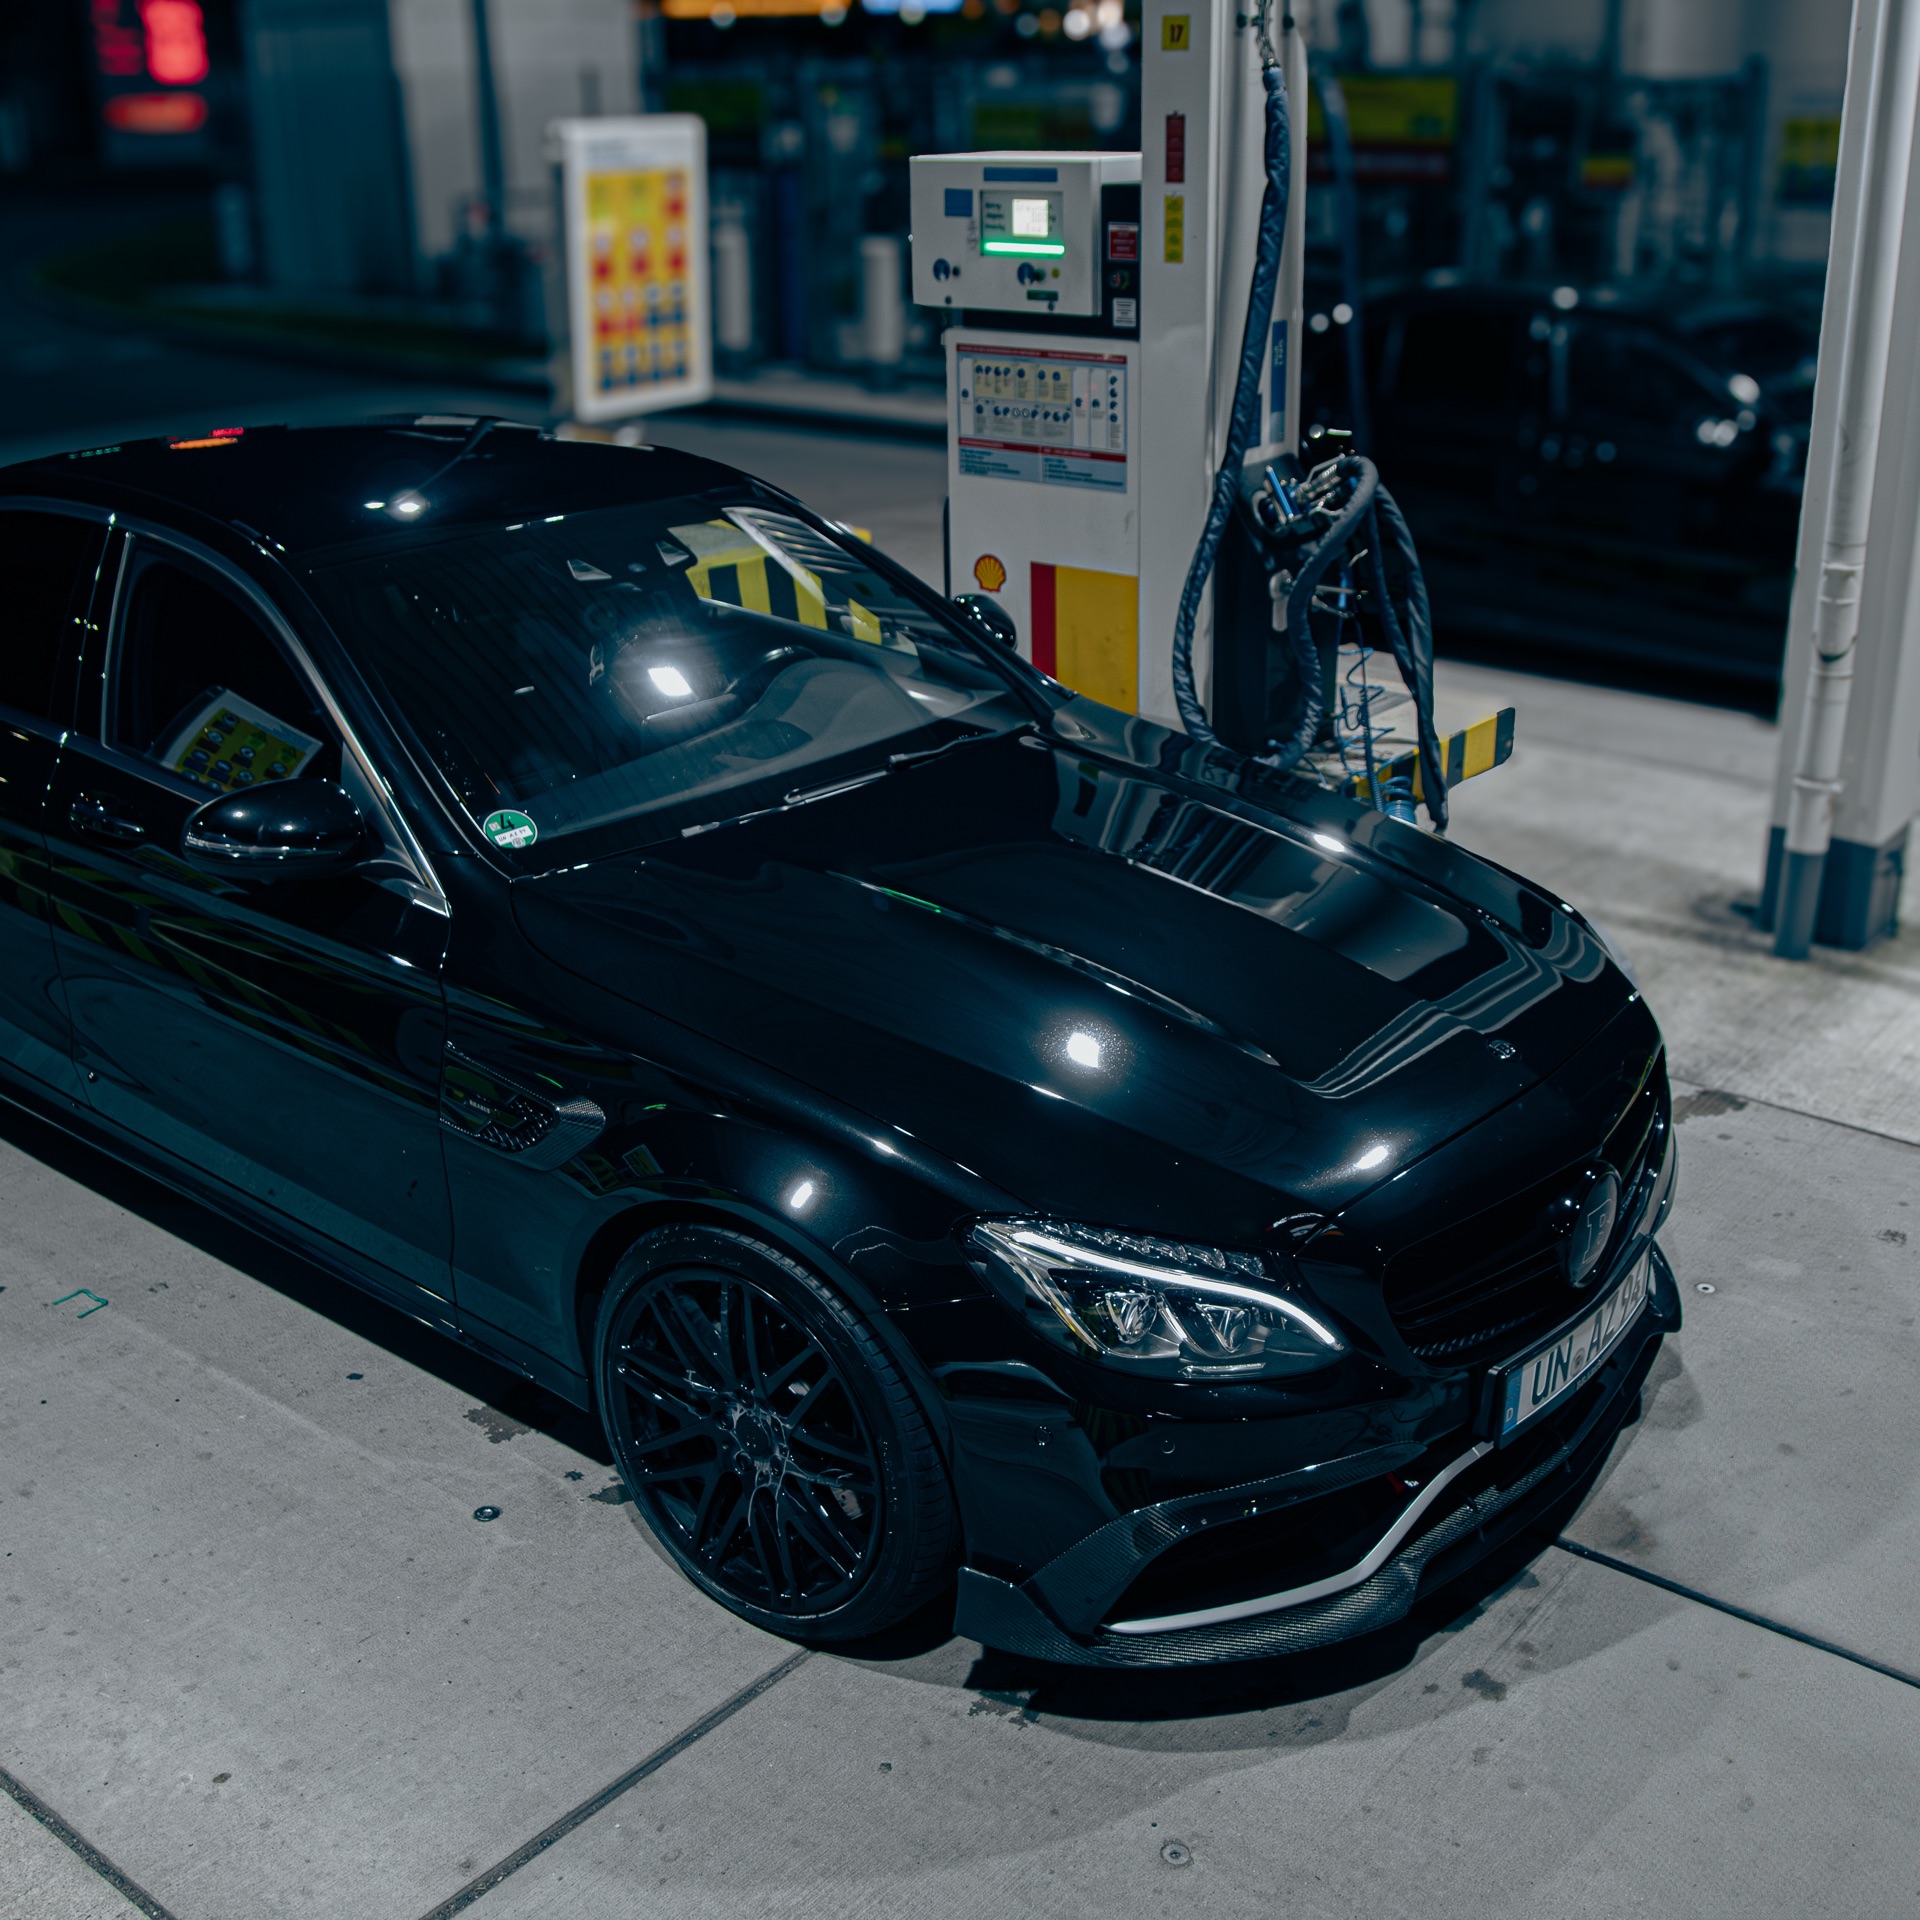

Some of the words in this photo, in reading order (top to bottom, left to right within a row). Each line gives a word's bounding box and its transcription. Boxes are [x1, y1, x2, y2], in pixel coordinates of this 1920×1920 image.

[1170, 24, 1184, 43] 17
[500, 813, 515, 829] 4
[1531, 1335, 1573, 1405] UN
[1586, 1290, 1620, 1363] AZ
[1505, 1407, 1514, 1422] D
